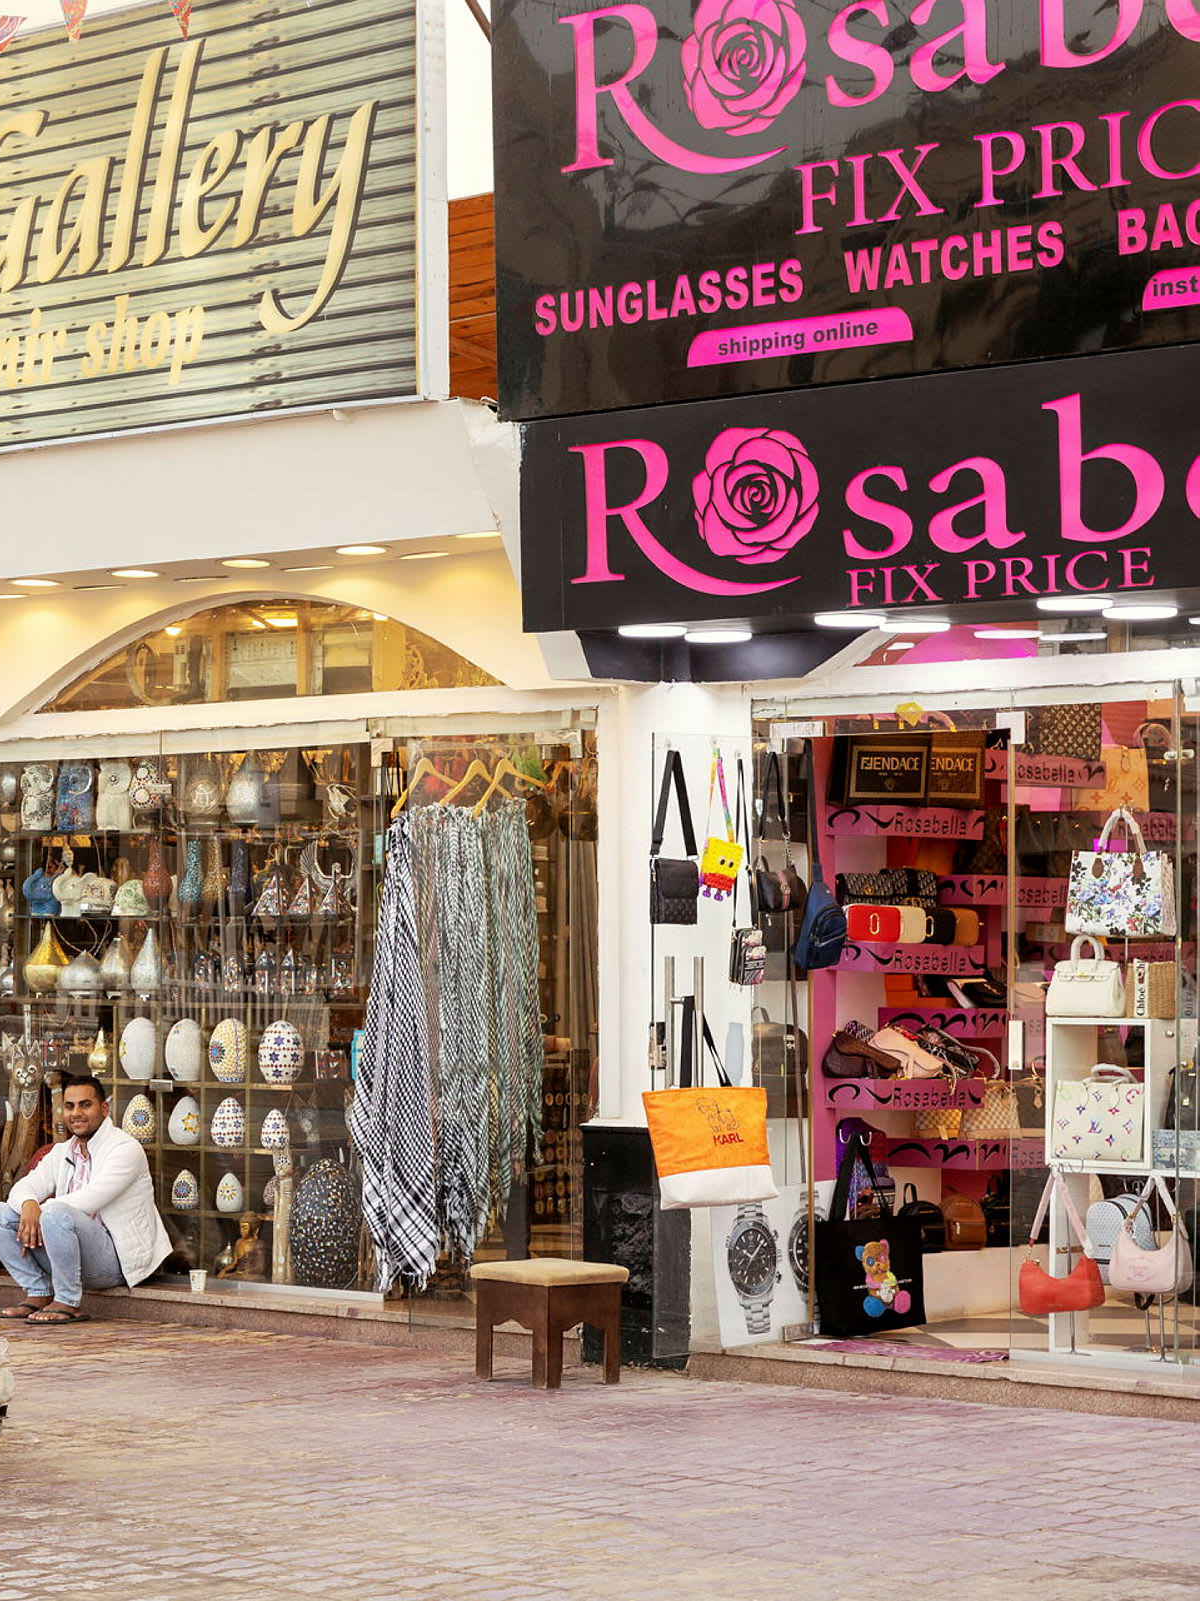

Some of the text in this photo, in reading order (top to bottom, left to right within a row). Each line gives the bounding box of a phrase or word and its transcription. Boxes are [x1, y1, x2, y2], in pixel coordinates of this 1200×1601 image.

[794, 99, 1200, 236] FIX PRIC
[534, 258, 804, 337] SUNGLASSES
[843, 220, 1065, 294] WATCHES
[81, 294, 205, 386] shop
[717, 319, 879, 357] shipping online
[846, 546, 1156, 607] FIX PRICE
[1015, 762, 1075, 783] osabella
[1136, 987, 1146, 1016] Chloé
[712, 1132, 744, 1145] KARL
